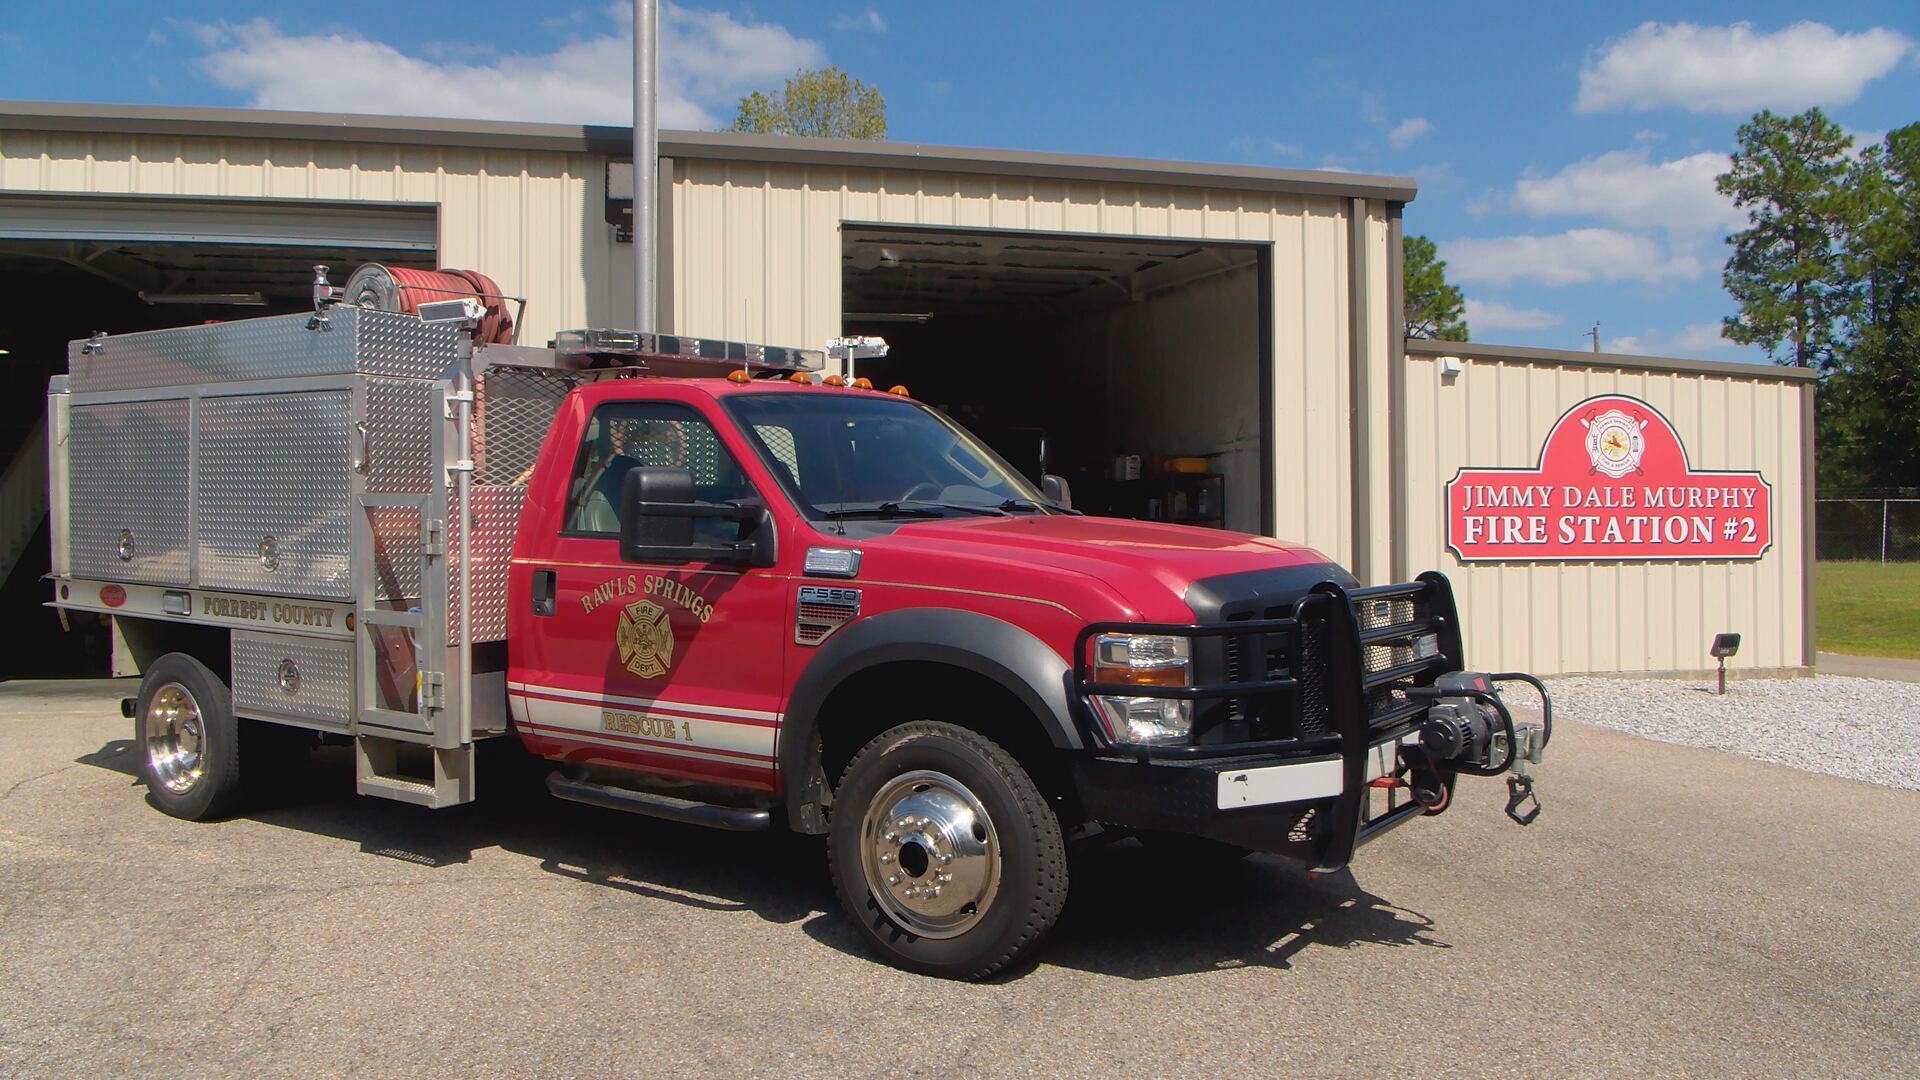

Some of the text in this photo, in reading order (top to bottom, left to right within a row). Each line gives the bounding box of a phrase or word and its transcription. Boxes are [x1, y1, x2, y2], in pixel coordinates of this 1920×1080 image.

[1462, 485, 1757, 511] JIMMY DALE MURPHY
[1463, 515, 1758, 545] FIRE STATION #2
[203, 597, 335, 628] FORREST COUNTY
[581, 574, 713, 624] RAWLS SPRINGS
[635, 605, 653, 616] FIRE
[602, 711, 693, 742] RESCUE 1
